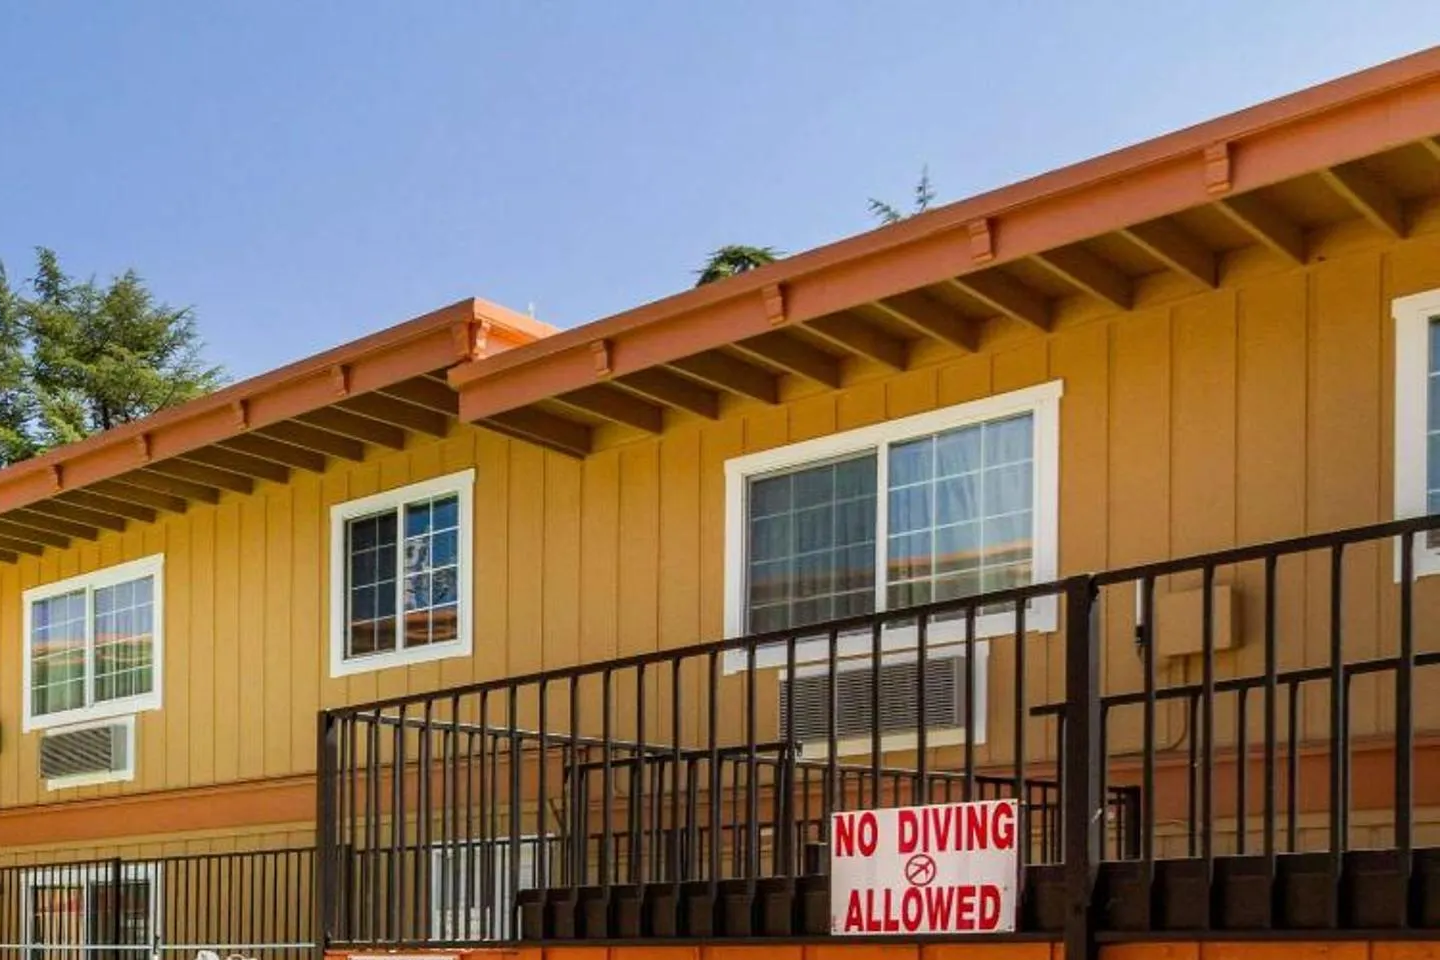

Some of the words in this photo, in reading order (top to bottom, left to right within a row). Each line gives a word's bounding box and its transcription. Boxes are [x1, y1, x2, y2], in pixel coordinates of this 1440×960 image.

[834, 812, 879, 857] NO
[898, 802, 1015, 854] DIVING
[844, 884, 1002, 933] ALLOWED
